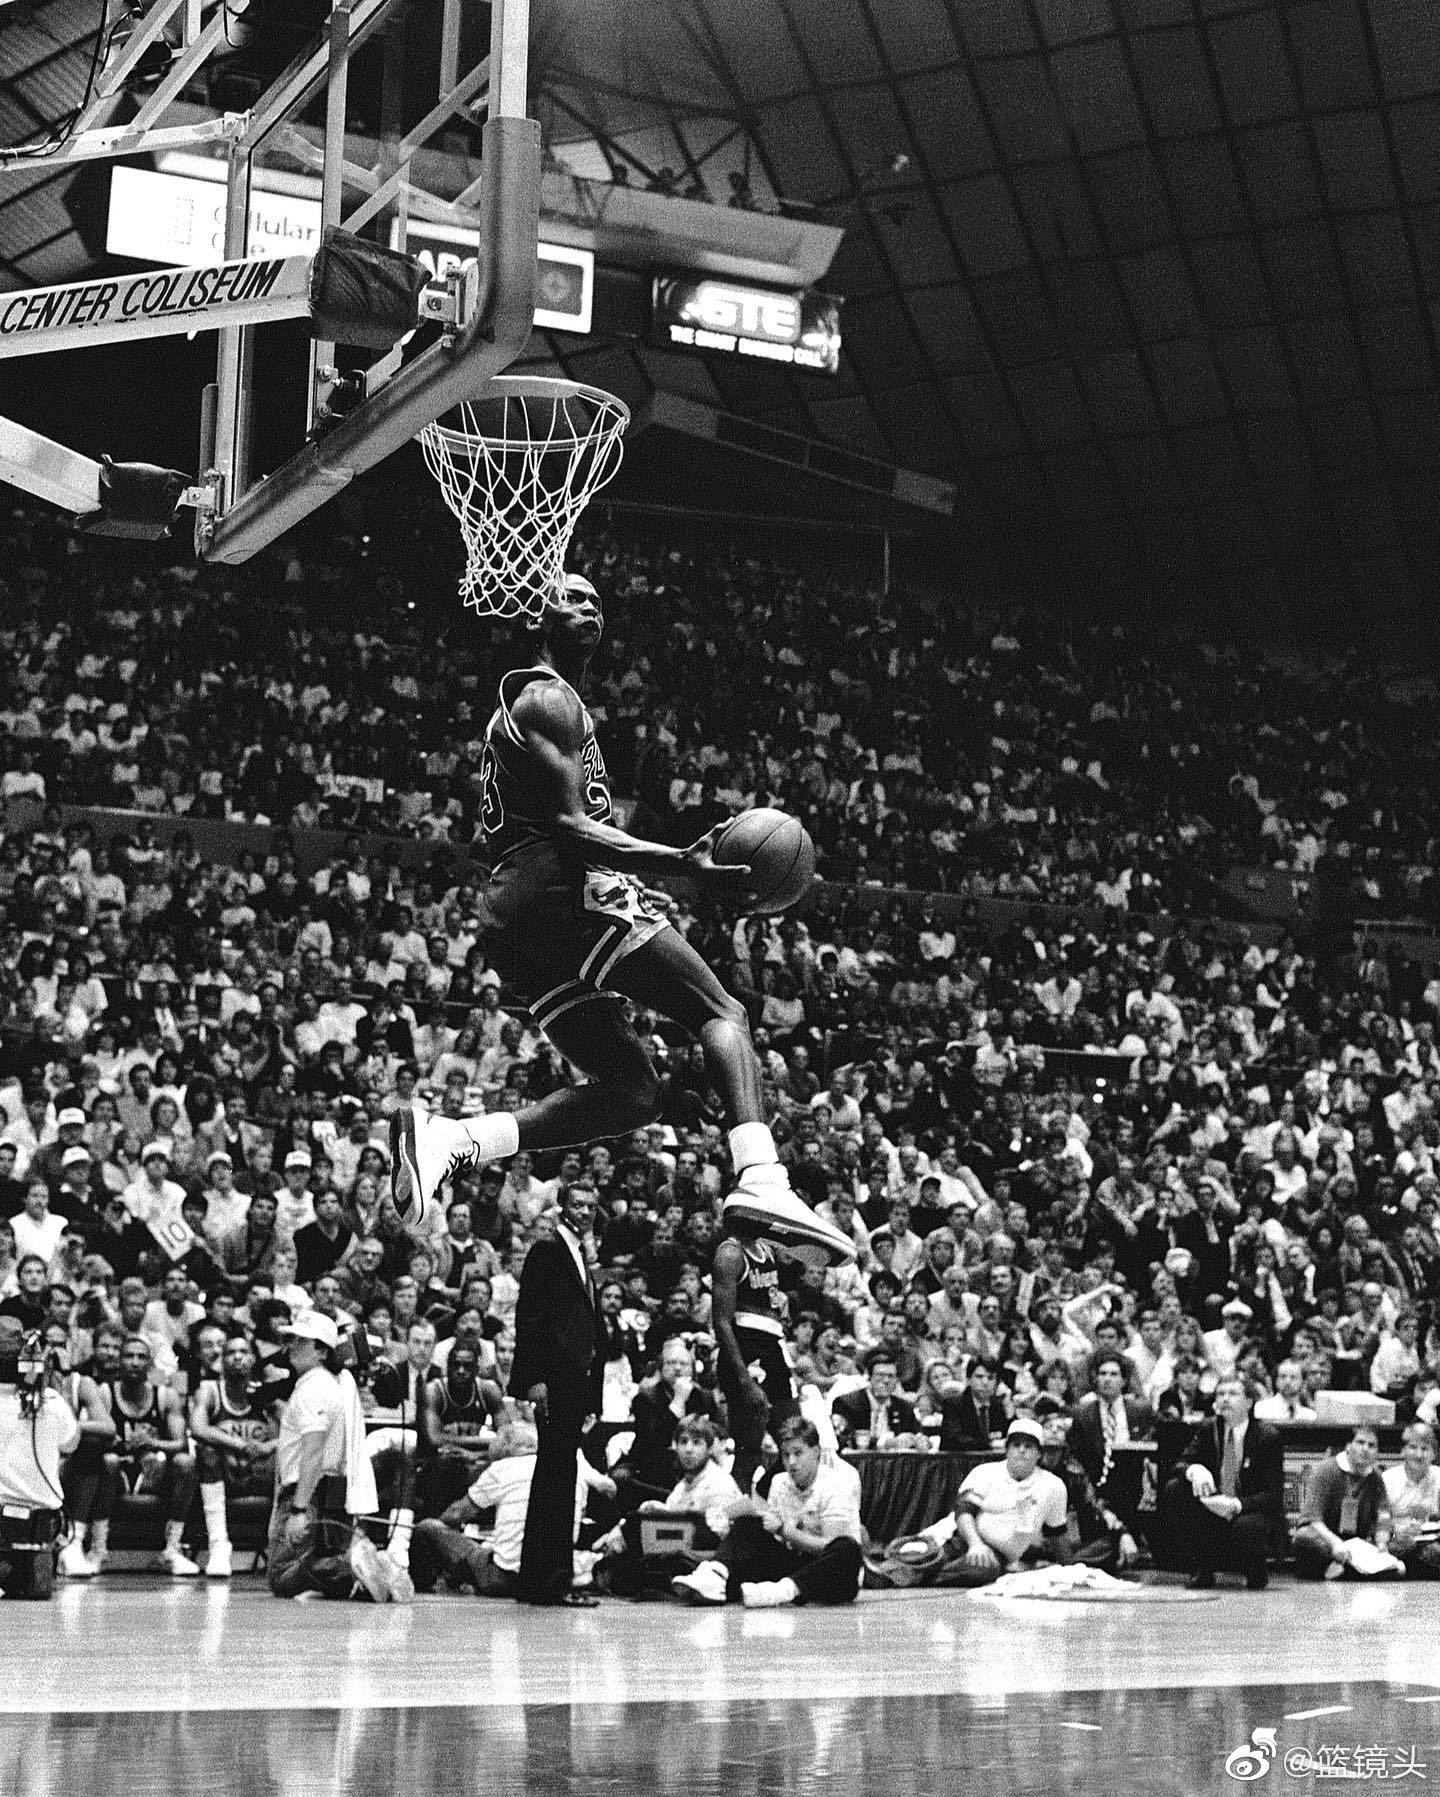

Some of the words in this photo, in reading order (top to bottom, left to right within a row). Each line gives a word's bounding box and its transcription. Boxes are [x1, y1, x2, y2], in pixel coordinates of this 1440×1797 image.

[0, 282, 119, 334] CENTER
[121, 258, 286, 316] COLISEUM
[160, 1221, 188, 1250] 10
